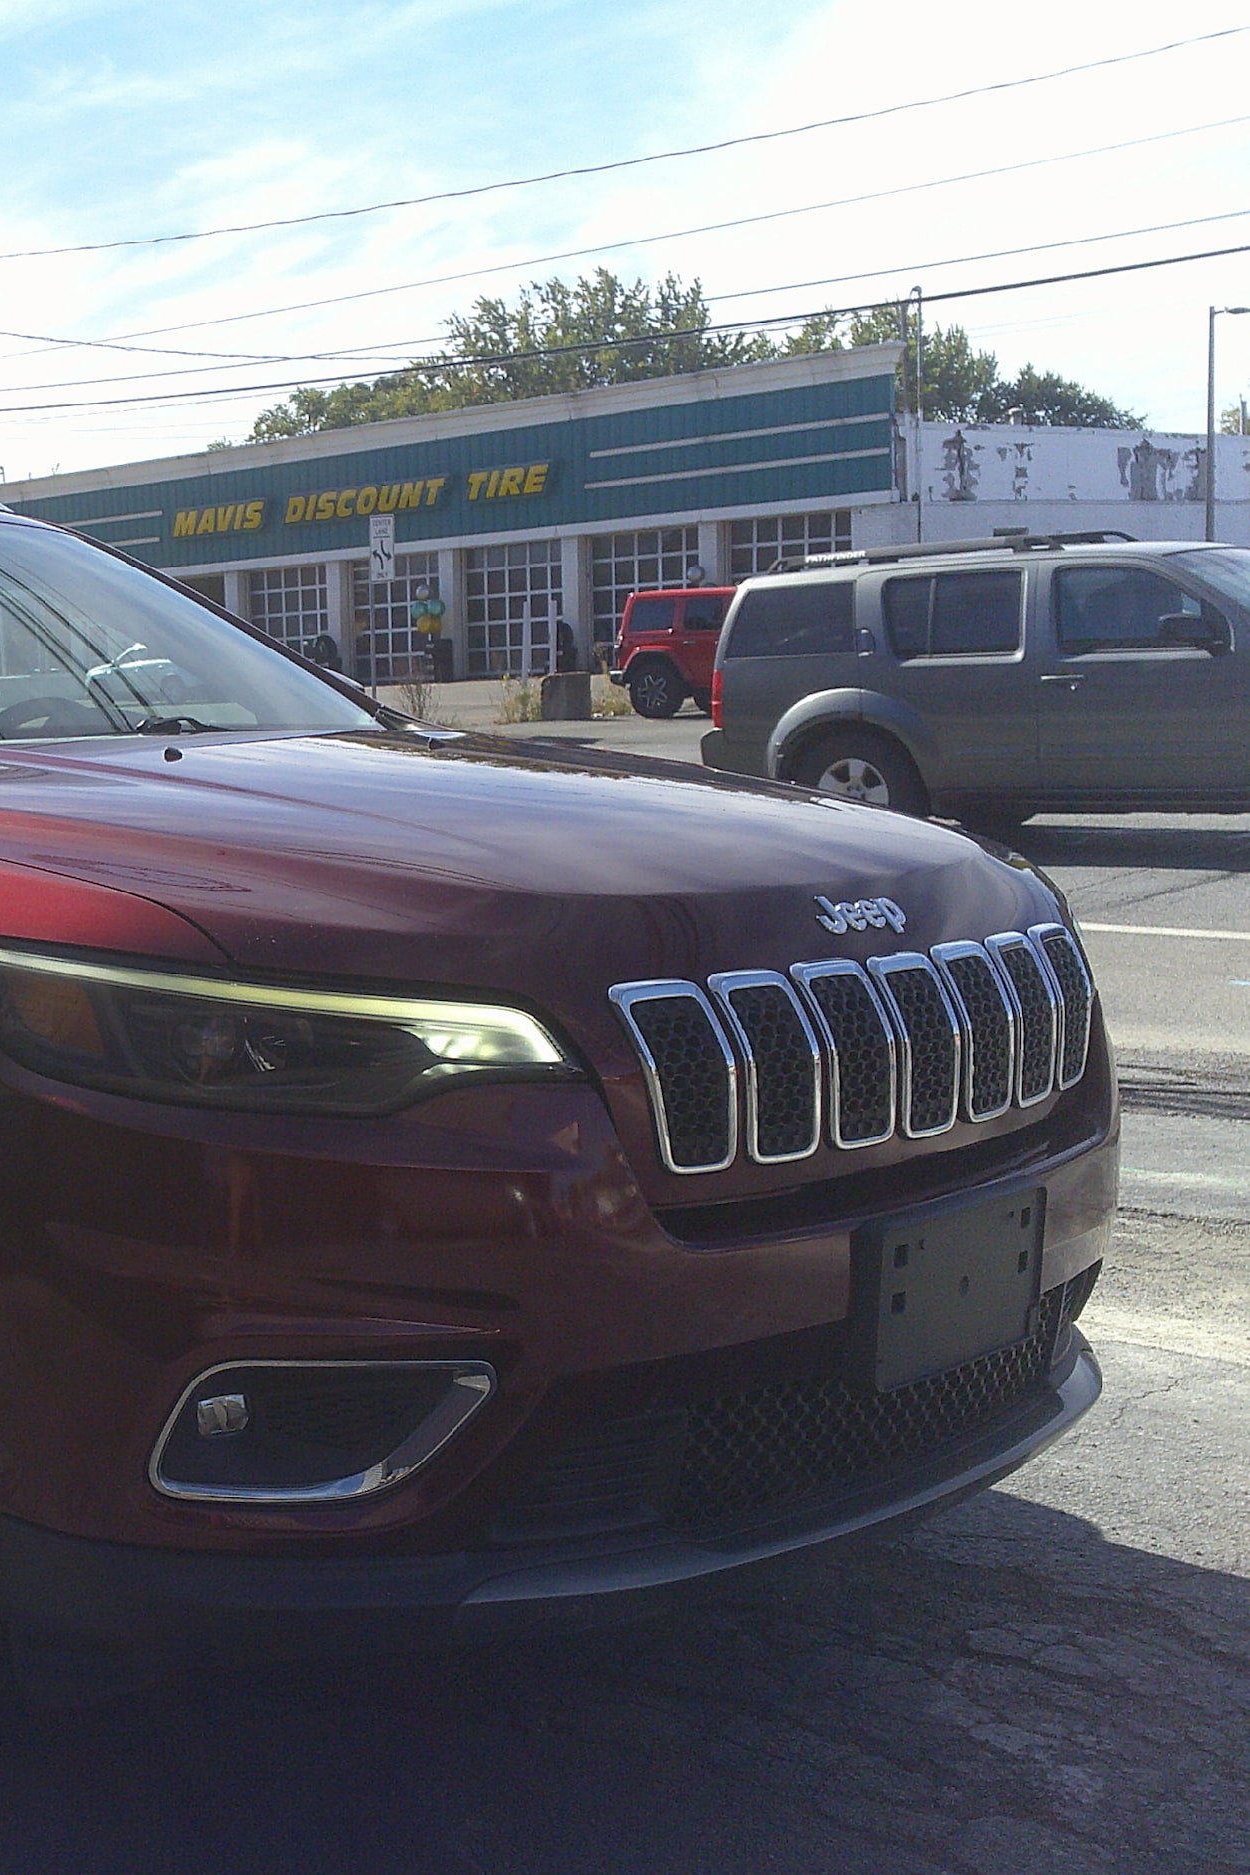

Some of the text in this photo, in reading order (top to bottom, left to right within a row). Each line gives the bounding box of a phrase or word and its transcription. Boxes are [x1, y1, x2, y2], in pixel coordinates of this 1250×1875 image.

[173, 464, 549, 538] MAVIS DISCOUNT TIRE
[805, 550, 866, 563] PATHFINDER
[813, 895, 907, 935] Jeep
